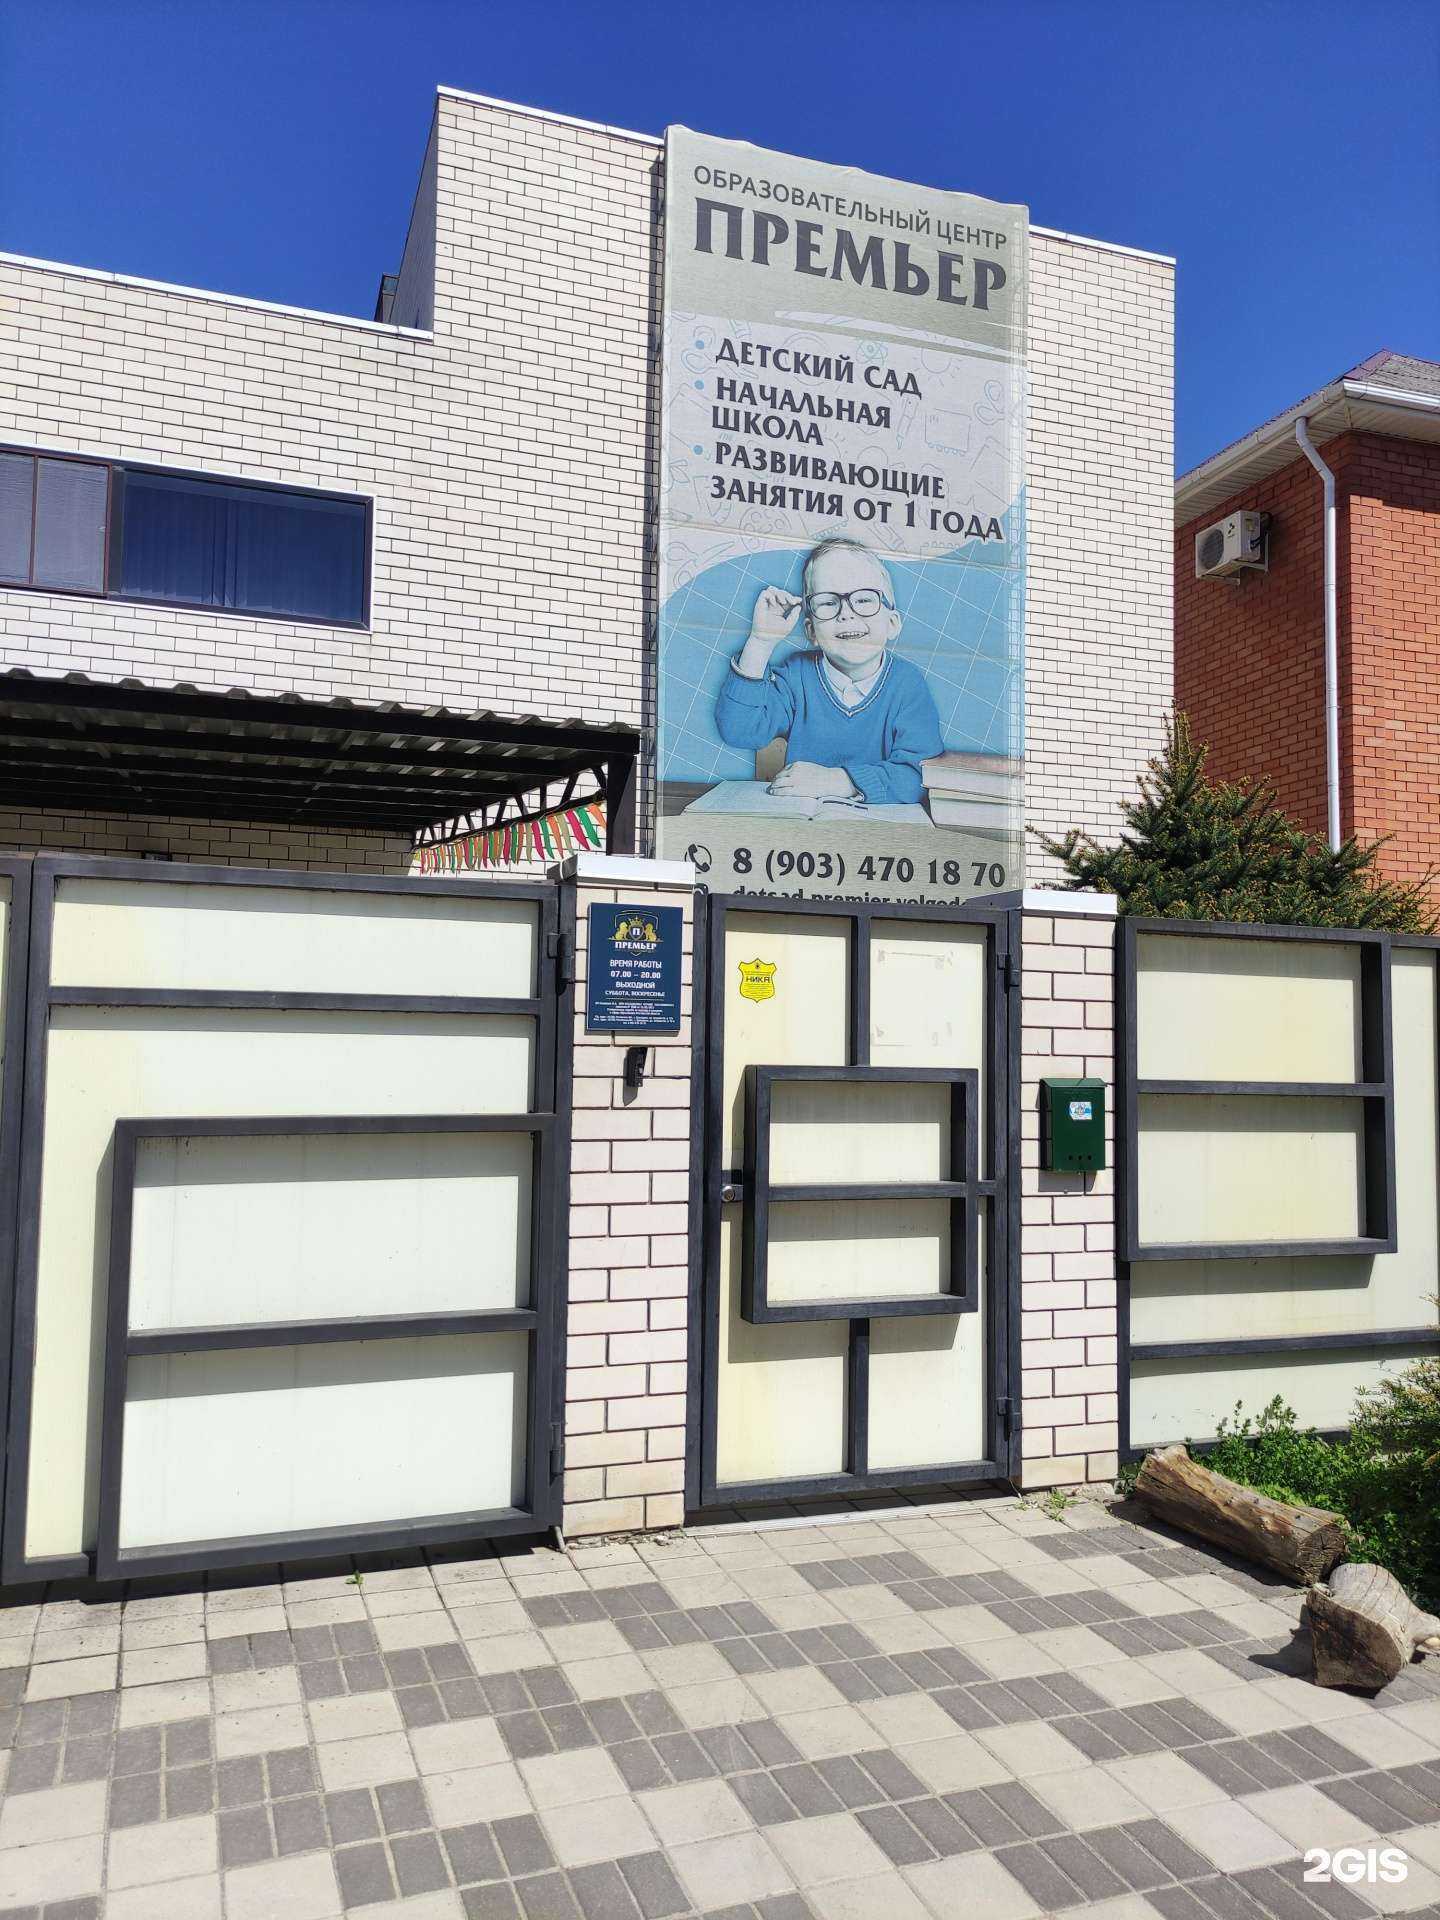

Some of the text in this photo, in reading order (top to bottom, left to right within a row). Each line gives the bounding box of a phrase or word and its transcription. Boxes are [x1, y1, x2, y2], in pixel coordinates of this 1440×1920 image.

[693, 164, 1007, 250] ОБРАЗОВАТЕЛЬНЫЙ ЦЕНТР
[693, 196, 1007, 310] ПРЕМЬЕР
[715, 338, 922, 400] ДЕТСКИЙ САД
[711, 405, 825, 446] ШКОЛА
[715, 376, 892, 429] НАЧАЛЬНАЯ
[715, 441, 946, 500] РАЗВИВАЮЩИЕ
[710, 475, 1004, 542] ЗАНЯТИЯ ОТ 1 ГОДА
[732, 847, 1006, 888] 8 (903) 470 18 70
[609, 959, 662, 969] ВРЕМЯ РАБОТЫ
[614, 941, 657, 950] ПРЕМЬЕР
[610, 970, 632, 978] 07.00
[640, 971, 661, 979] 20.00
[615, 981, 656, 989] ВЫХОДНОЙ
